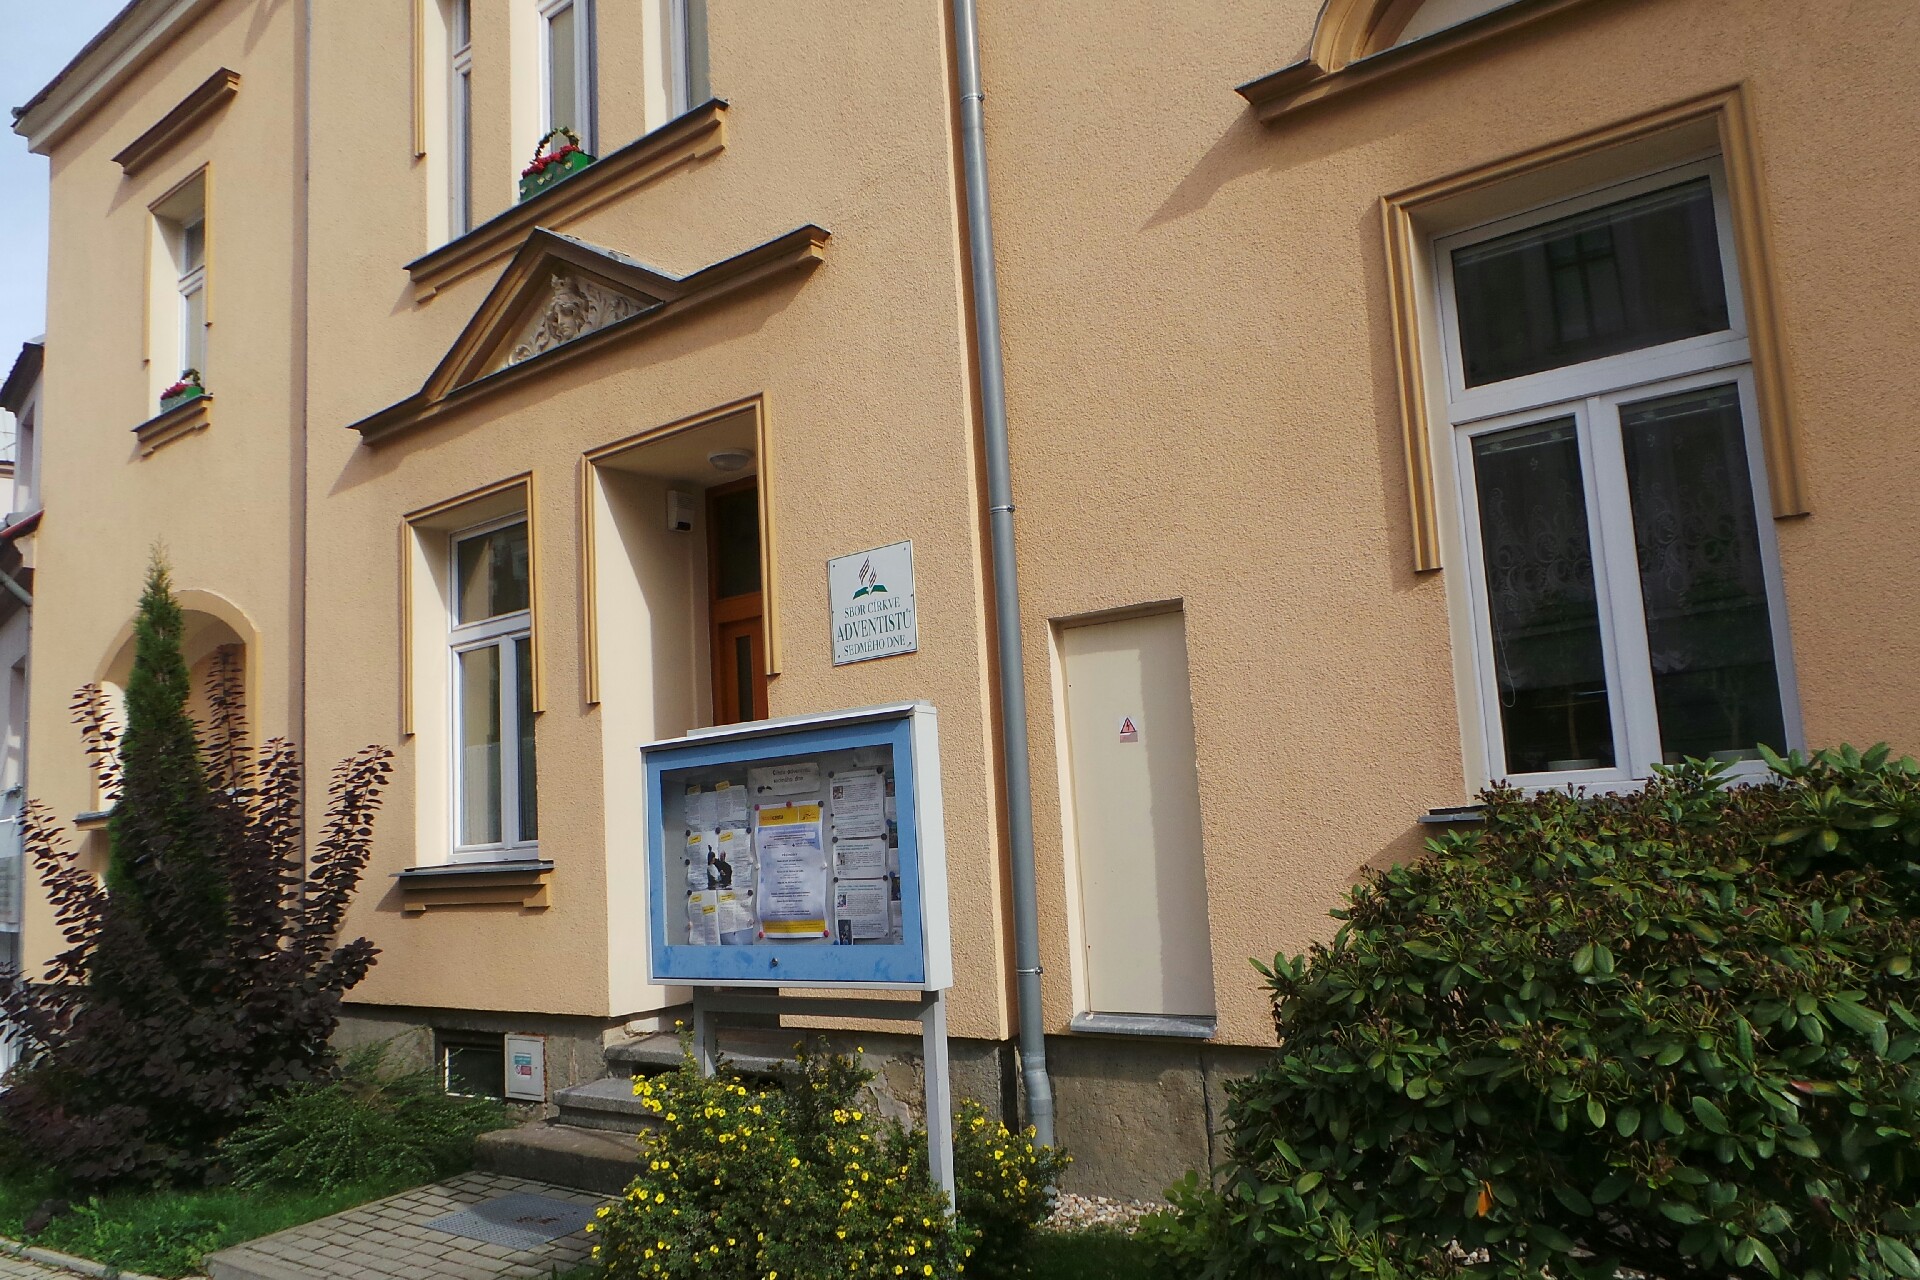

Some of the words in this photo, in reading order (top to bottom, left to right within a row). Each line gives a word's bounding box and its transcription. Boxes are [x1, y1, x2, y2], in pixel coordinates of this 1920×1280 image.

[844, 604, 866, 619] SBOR
[867, 597, 900, 613] CÍRKVE
[837, 608, 911, 642] ADVENTISTŮ
[844, 639, 885, 656] SEDMÉHO
[886, 635, 905, 647] DNE
